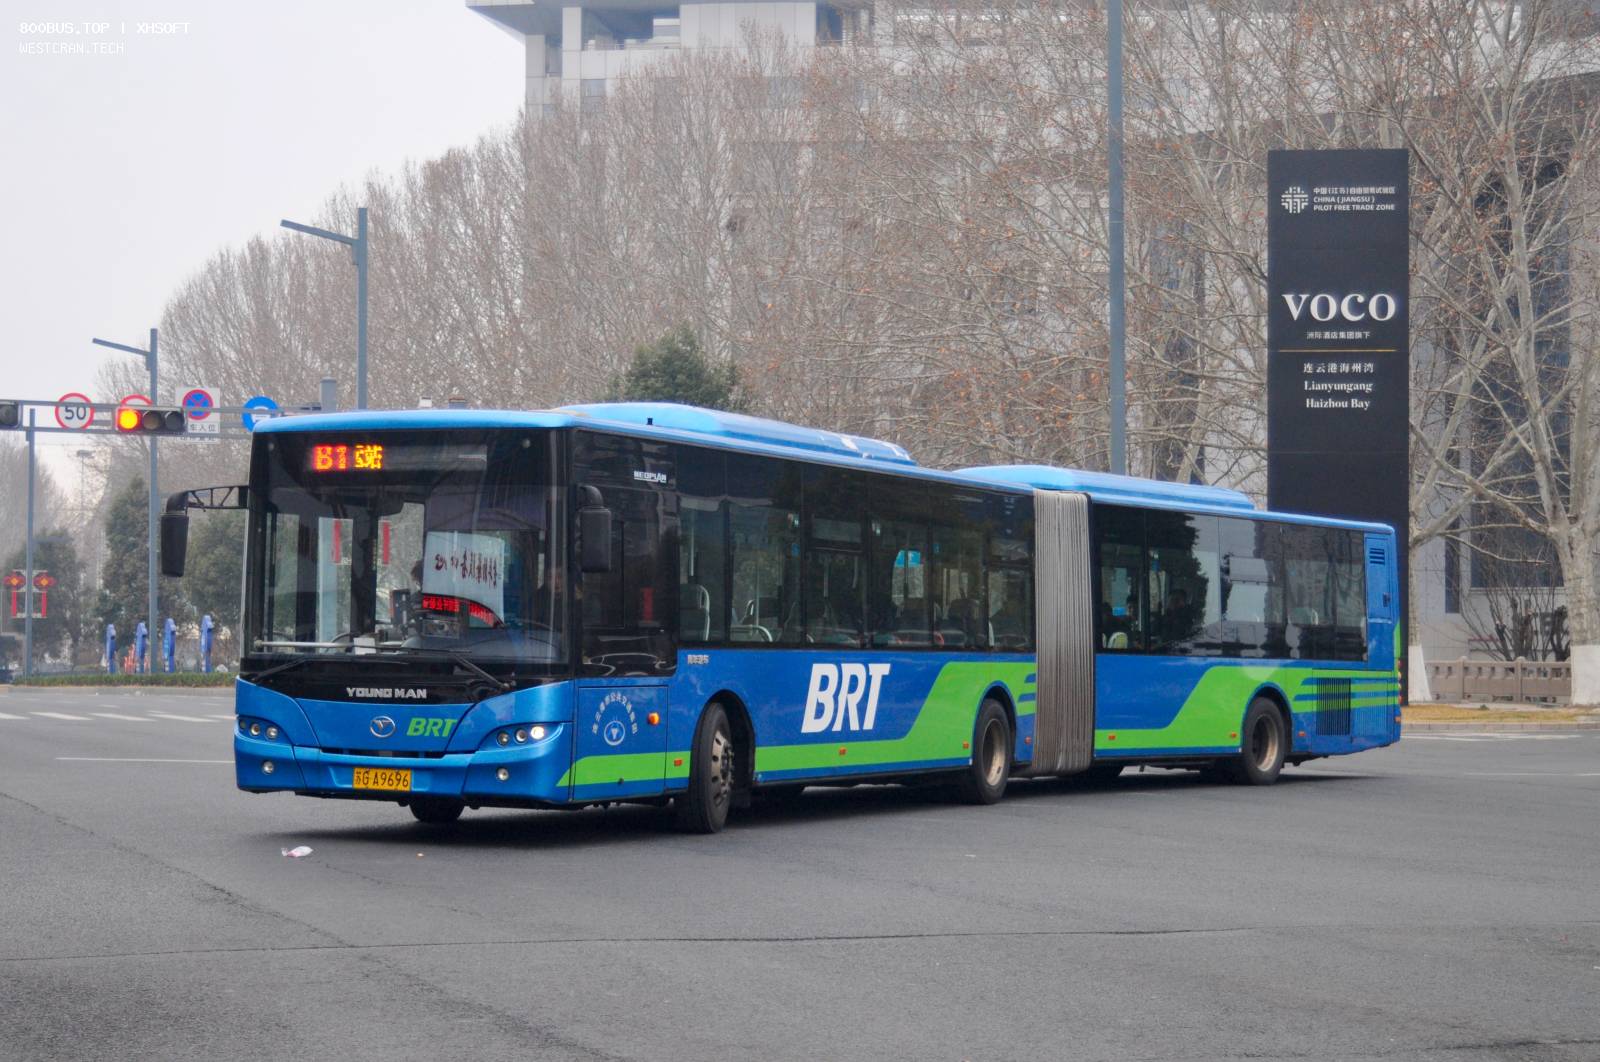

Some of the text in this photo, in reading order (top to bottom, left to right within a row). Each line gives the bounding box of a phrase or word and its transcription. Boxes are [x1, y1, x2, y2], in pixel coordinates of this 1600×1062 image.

[1303, 363, 1374, 373] 连云港海州湾
[1304, 381, 1373, 393] Lianyungang
[1306, 398, 1370, 410] Haizhou Bay
[64, 405, 87, 420] 50
[314, 445, 347, 469] B1
[346, 687, 427, 698] YOUNG MAN
[801, 663, 891, 733] BRT
[406, 717, 457, 737] BRT
